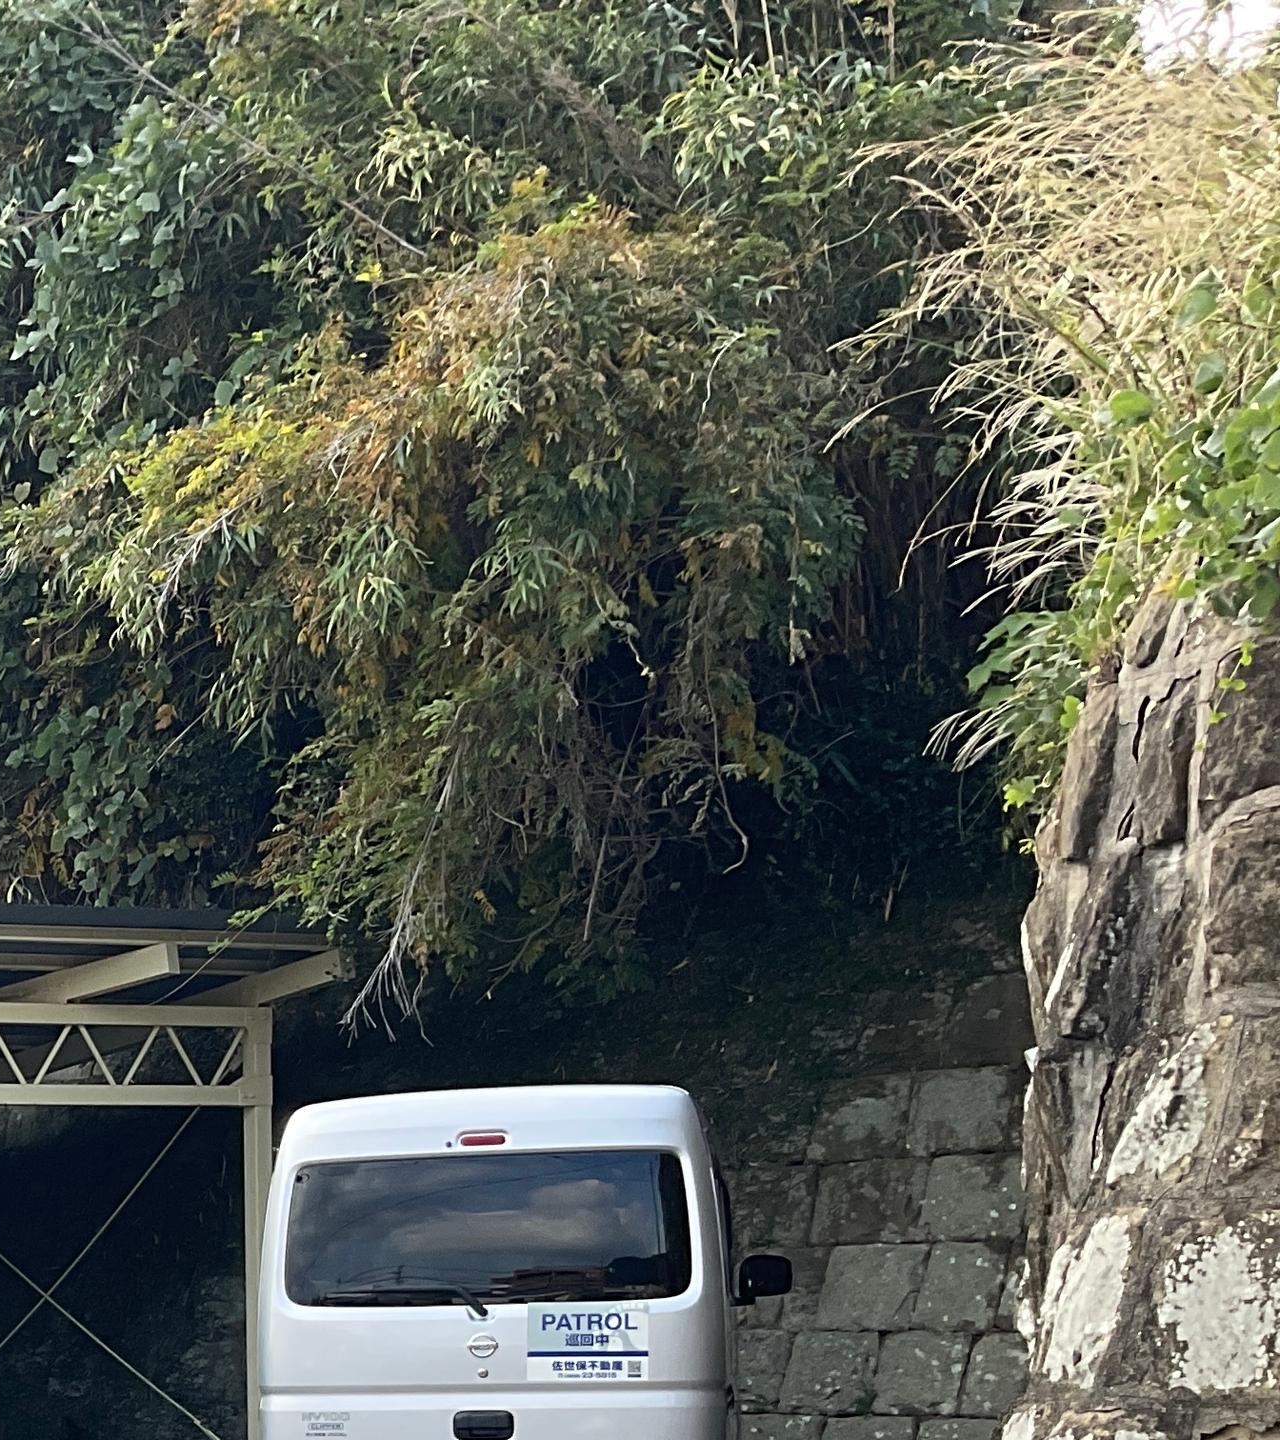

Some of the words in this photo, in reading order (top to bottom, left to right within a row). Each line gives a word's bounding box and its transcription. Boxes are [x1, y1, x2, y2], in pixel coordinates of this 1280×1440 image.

[542, 1313, 638, 1331] PATROL
[565, 1333, 609, 1347] 巡回中
